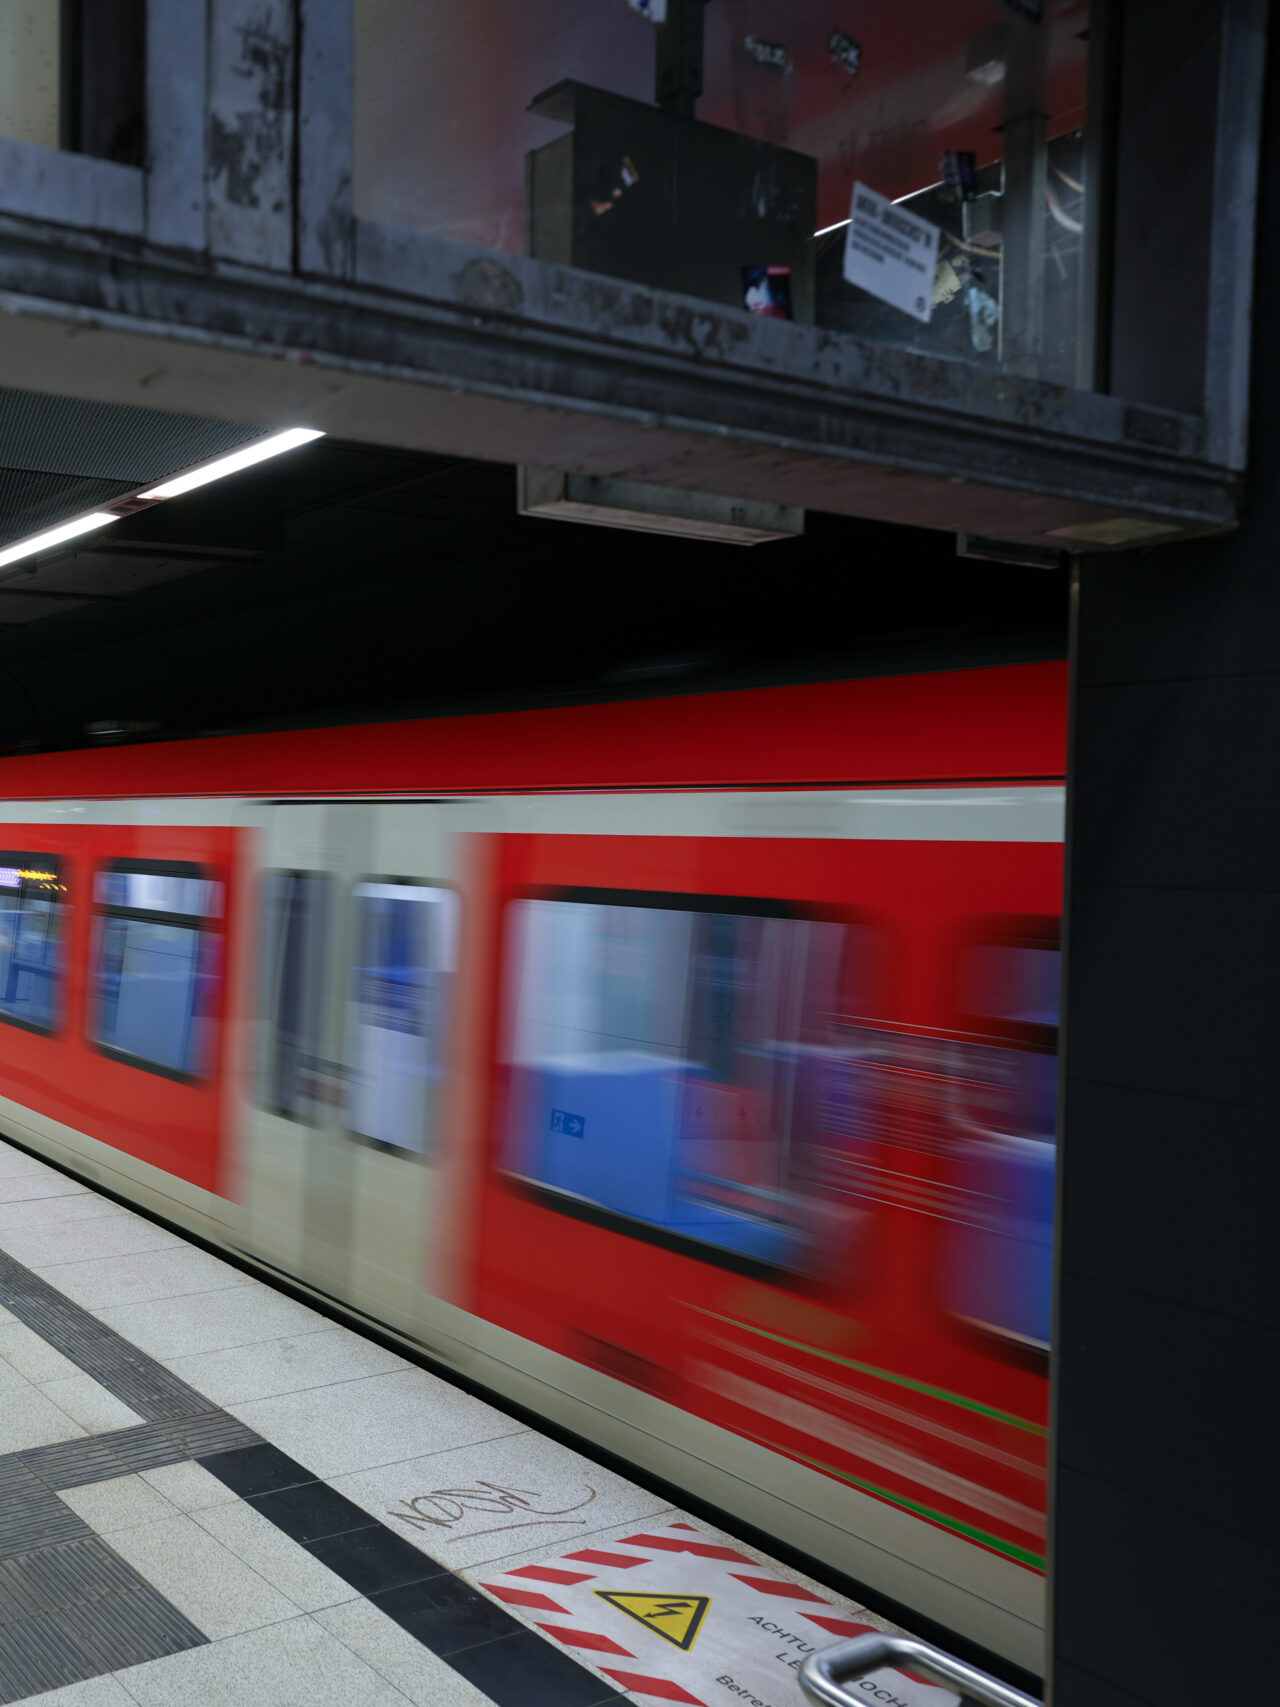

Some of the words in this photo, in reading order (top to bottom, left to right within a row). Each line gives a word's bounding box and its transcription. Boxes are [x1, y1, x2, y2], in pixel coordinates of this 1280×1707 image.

[747, 1615, 816, 1653] ACHTU
[775, 1652, 802, 1671] LE
[716, 1675, 772, 1707] Betre
